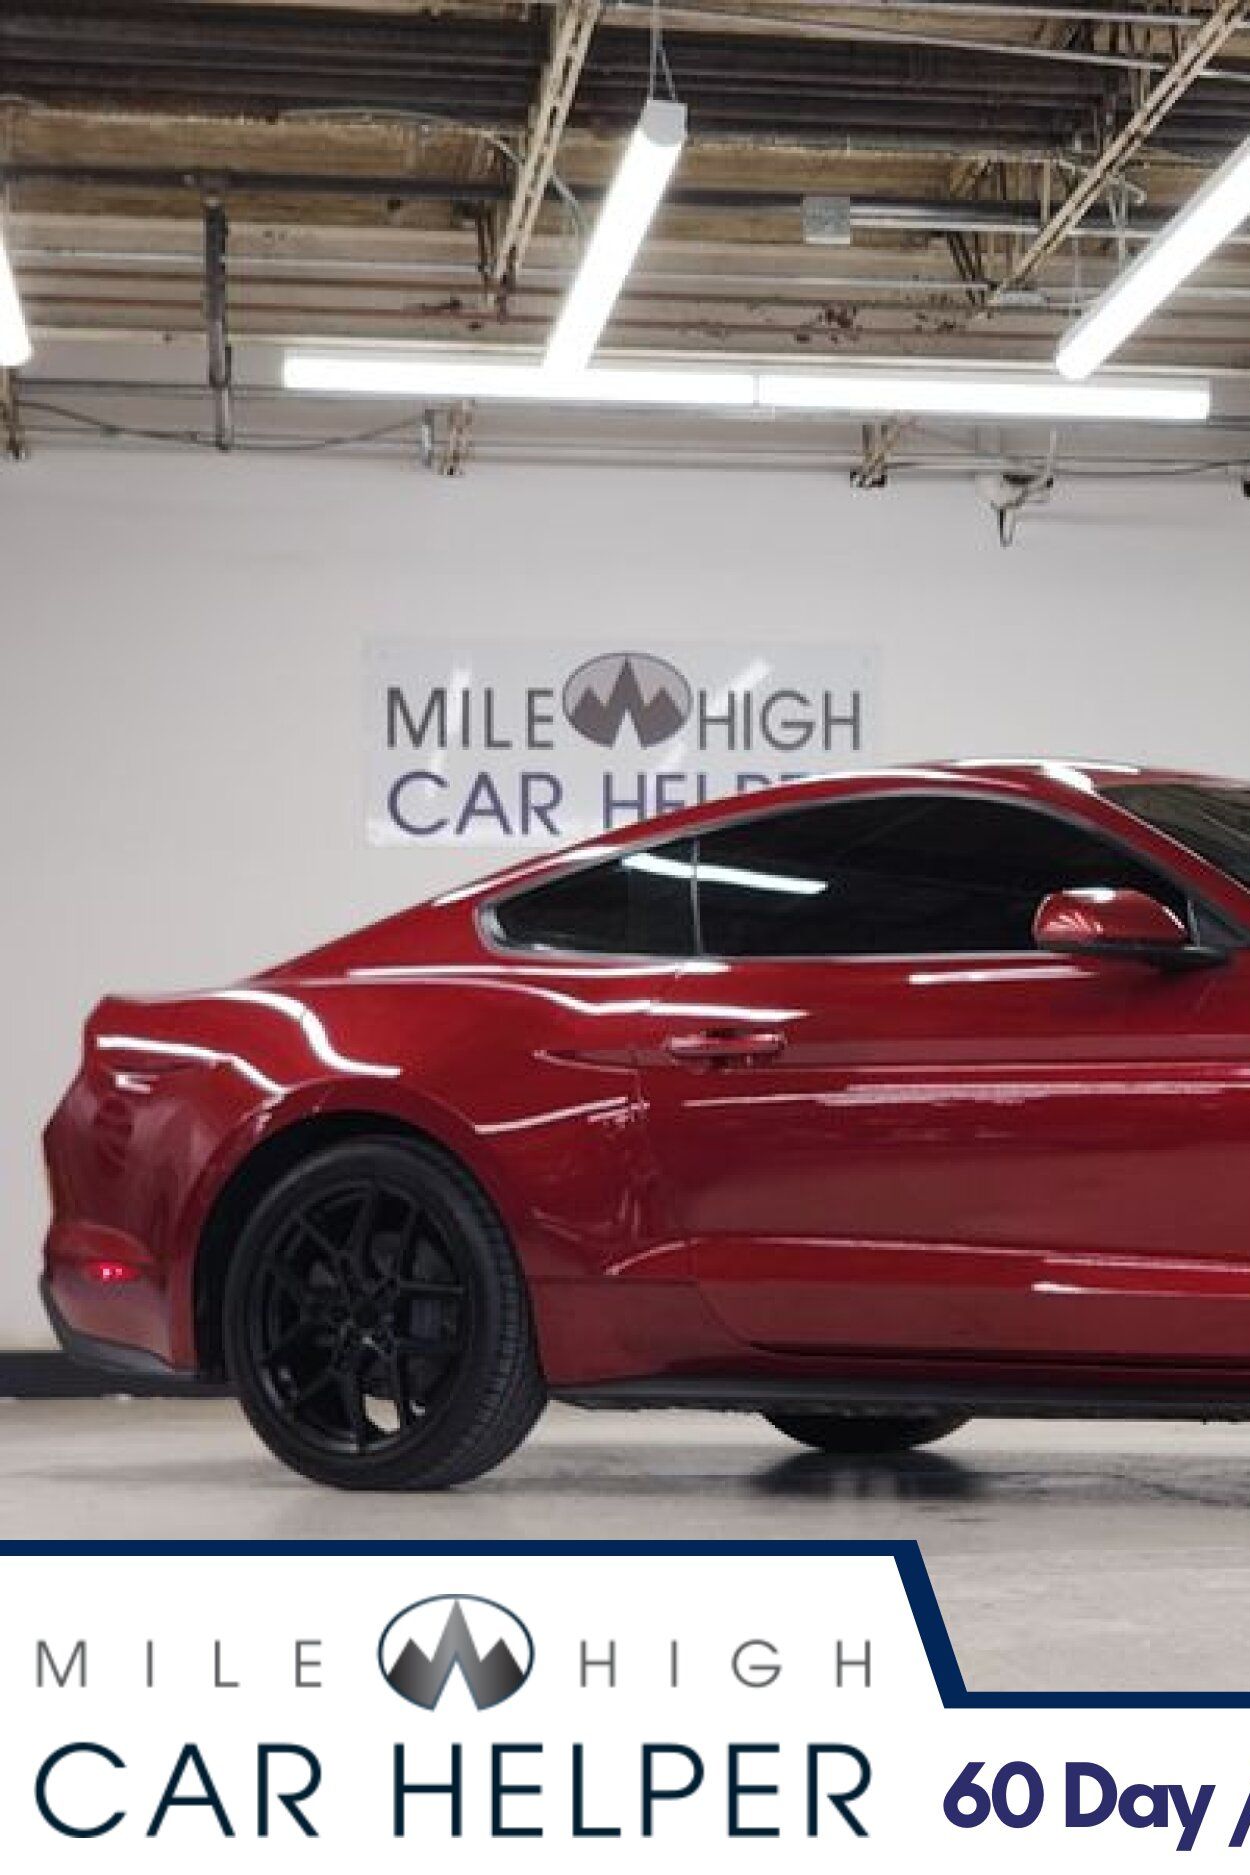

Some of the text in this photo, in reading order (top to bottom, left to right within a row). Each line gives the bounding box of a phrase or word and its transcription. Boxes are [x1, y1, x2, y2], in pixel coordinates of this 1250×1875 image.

[386, 686, 860, 751] MILE HIGH
[387, 770, 563, 835] CAR
